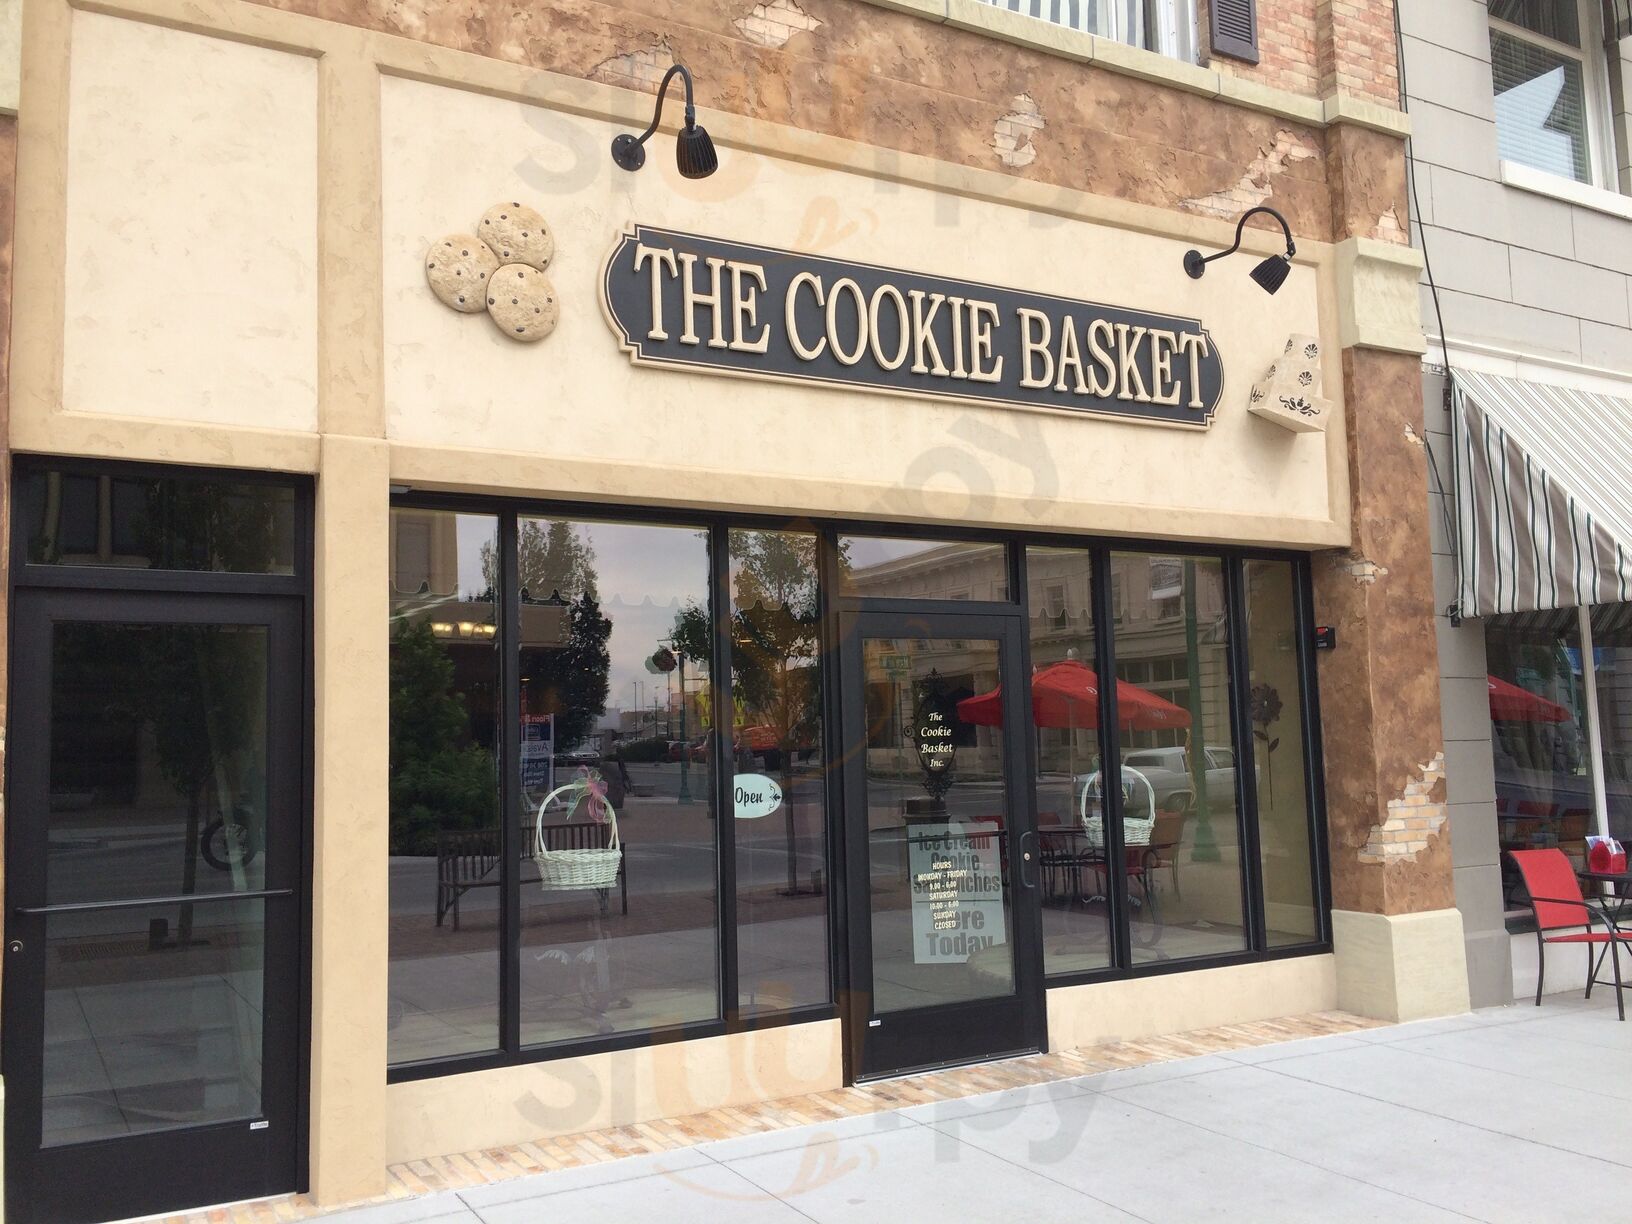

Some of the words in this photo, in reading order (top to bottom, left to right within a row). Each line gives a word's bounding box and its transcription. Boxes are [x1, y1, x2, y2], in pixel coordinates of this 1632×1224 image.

[633, 243, 771, 354] THE
[784, 271, 1004, 383] COOKIE
[1017, 307, 1209, 408] BASKET
[928, 711, 943, 721] The
[921, 725, 952, 737] Cookie
[921, 741, 953, 753] Basket
[735, 786, 763, 807] Open
[918, 831, 940, 851] Ice
[944, 830, 990, 850] Cream
[931, 852, 980, 871] Cookie
[932, 861, 952, 870] HOURS
[935, 920, 956, 930] CLOSED
[926, 932, 993, 956] Today
